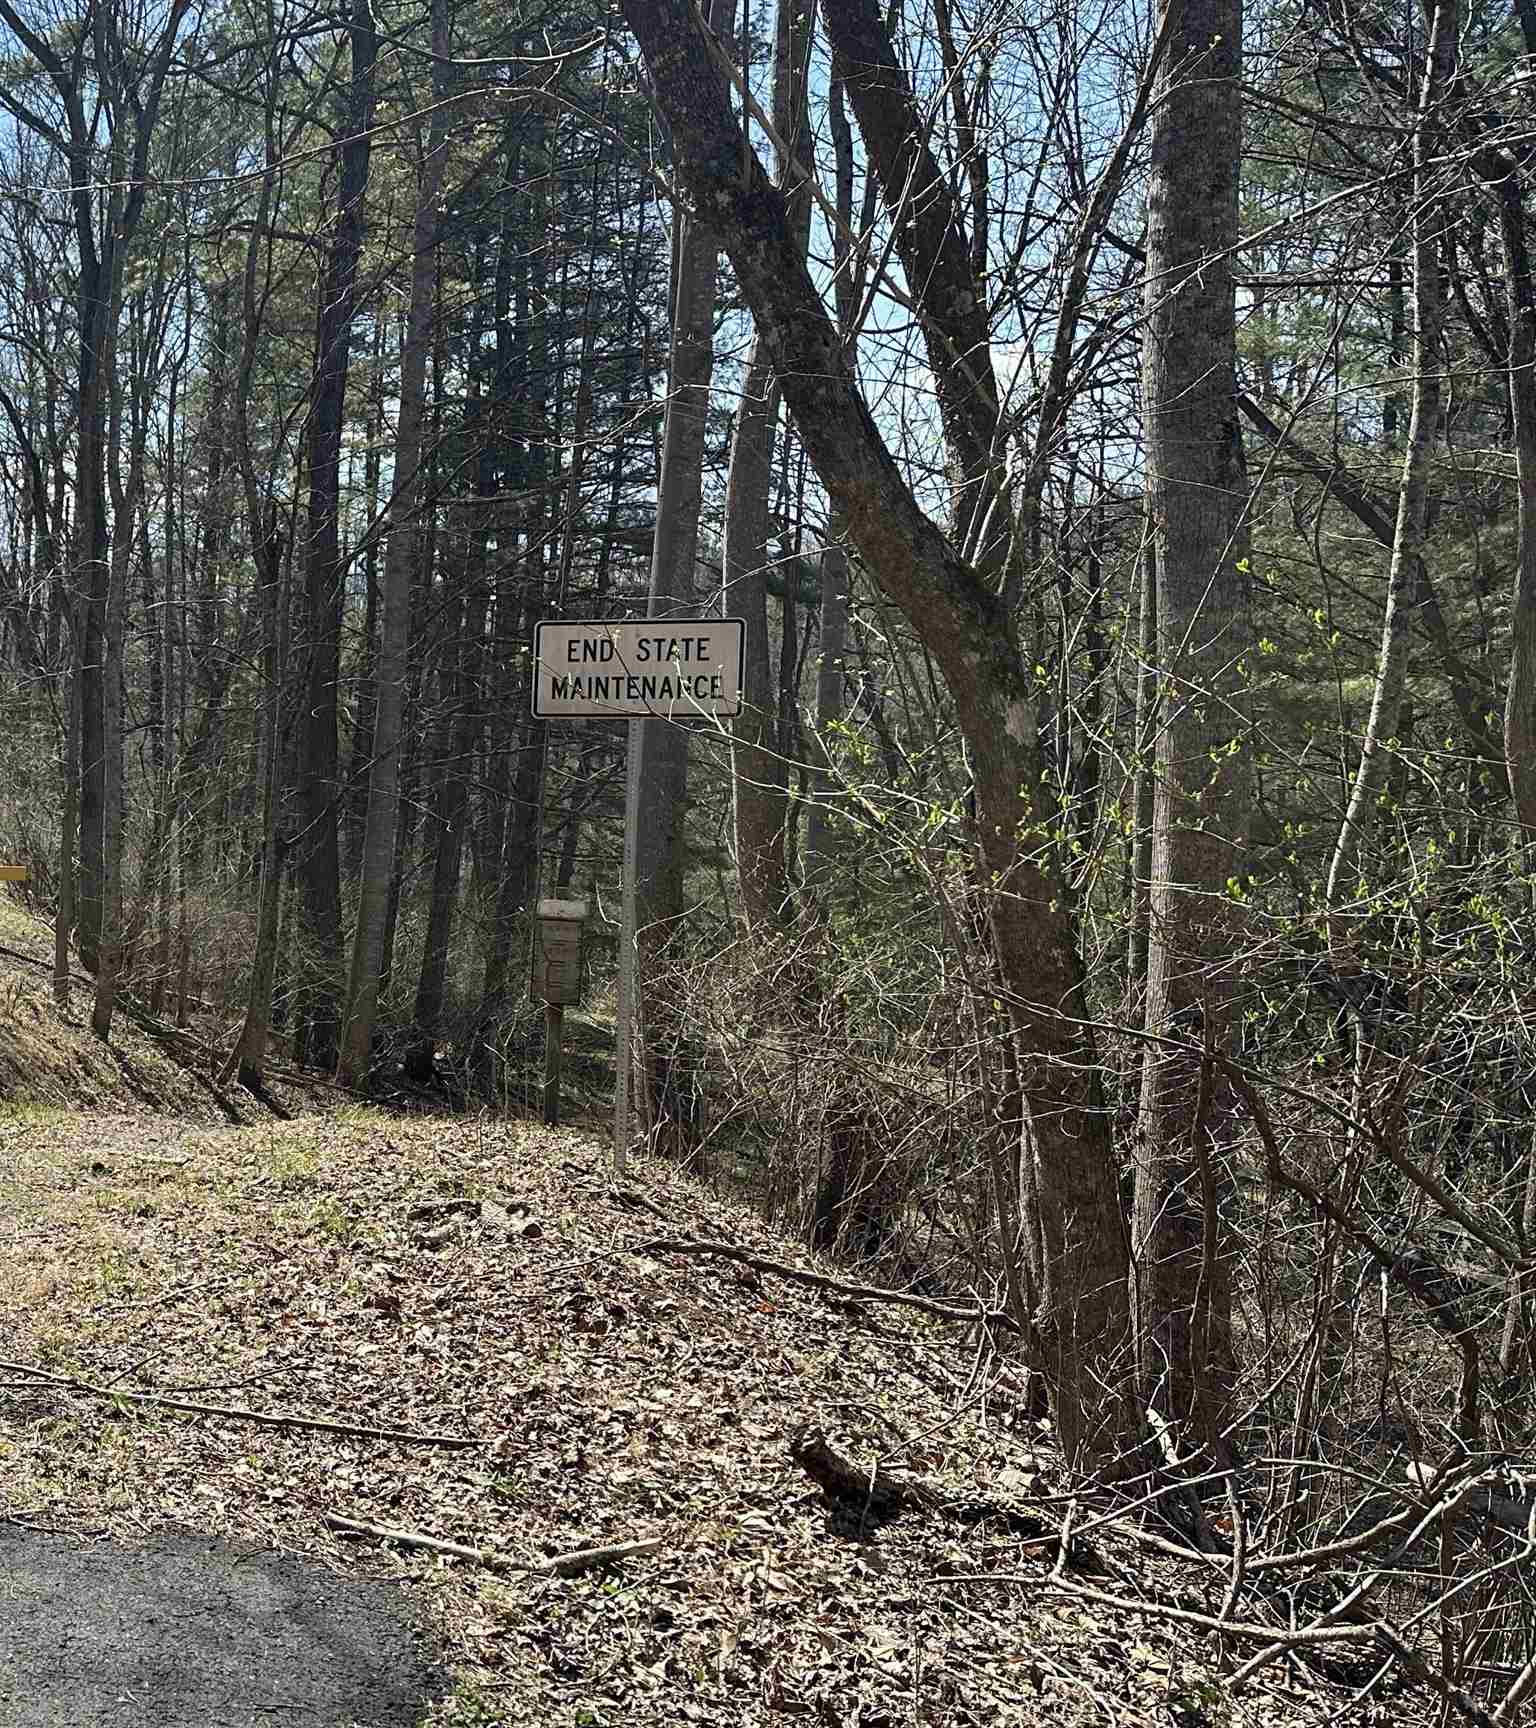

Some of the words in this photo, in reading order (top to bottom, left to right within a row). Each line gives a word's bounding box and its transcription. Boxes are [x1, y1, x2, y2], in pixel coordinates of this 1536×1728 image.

[567, 638, 614, 662] END
[636, 637, 710, 662] STATE
[551, 675, 723, 700] MAINTENANCE
